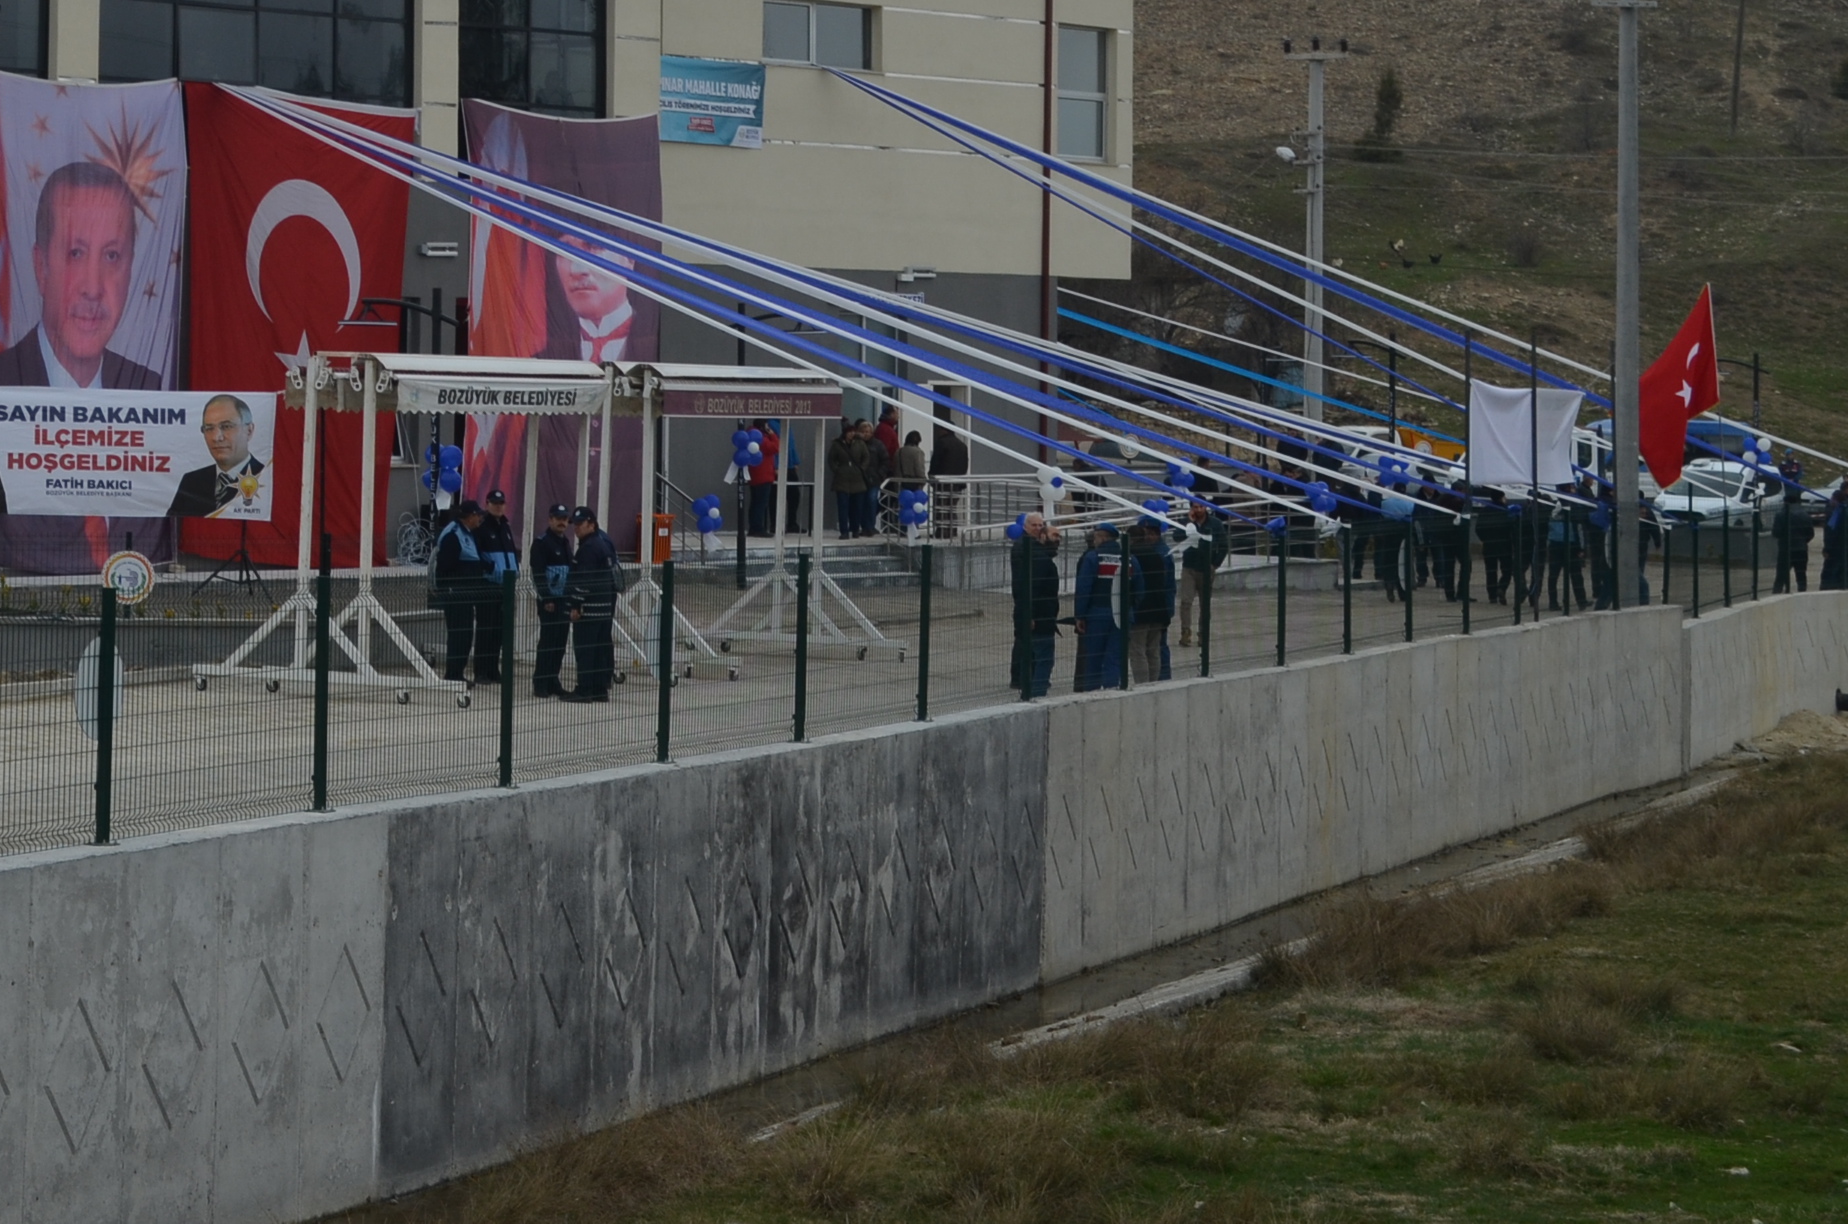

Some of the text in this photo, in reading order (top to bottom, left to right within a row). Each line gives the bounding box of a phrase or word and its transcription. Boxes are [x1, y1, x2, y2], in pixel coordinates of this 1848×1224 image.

[661, 77, 761, 100] INAR MAHALLE KONAĞI
[437, 386, 578, 407] BOZÜYÜK BELEDİYESİ
[707, 395, 745, 414] BOZÜYÜK
[748, 396, 792, 414] BELEDİYESİ
[72, 405, 187, 426] BAKANIM
[34, 424, 145, 449] İLÇEMİZE
[7, 450, 172, 474] HOŞGELDİNİZ
[45, 477, 132, 490] FATİH BAKICI
